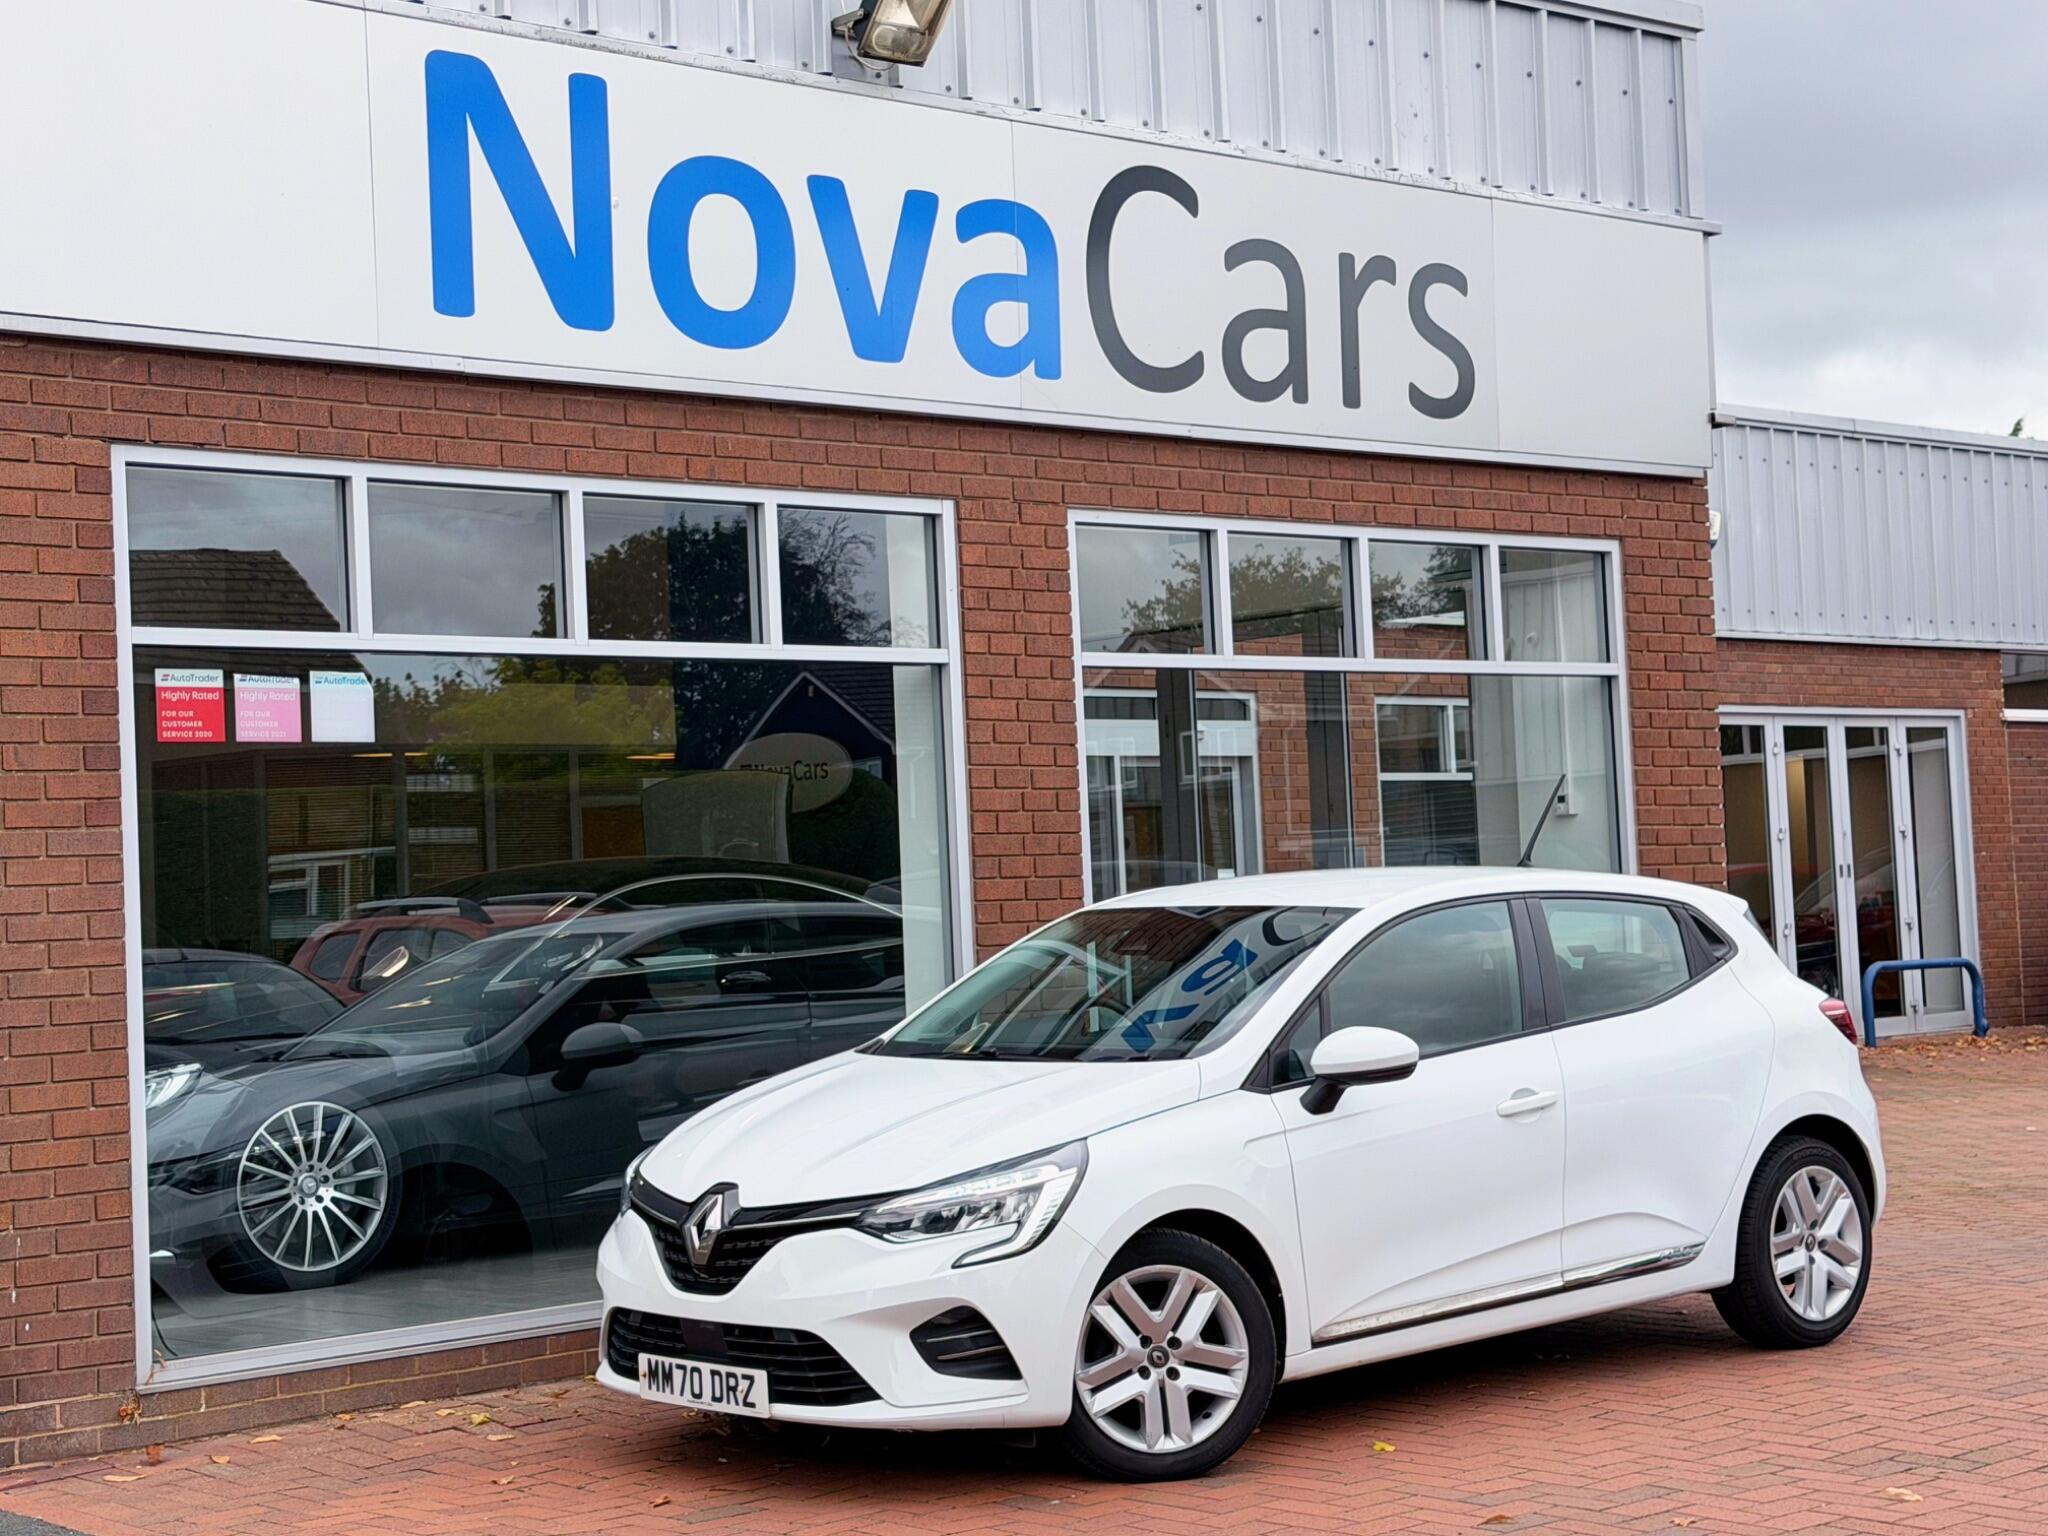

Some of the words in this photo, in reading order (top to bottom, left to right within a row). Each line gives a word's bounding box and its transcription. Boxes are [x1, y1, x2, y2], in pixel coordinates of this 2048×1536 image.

[426, 50, 1475, 419] NovaCars
[170, 673, 219, 682] AutoTrader
[161, 691, 190, 702] Highly
[192, 691, 219, 700] Rated
[240, 691, 268, 702] Highly
[162, 710, 177, 718] FOR
[178, 710, 194, 718] OUR
[162, 720, 203, 728] CUSTOMER
[162, 730, 194, 738] SERVICE
[647, 1357, 703, 1400] MM70
[710, 1368, 757, 1409] DRZ
